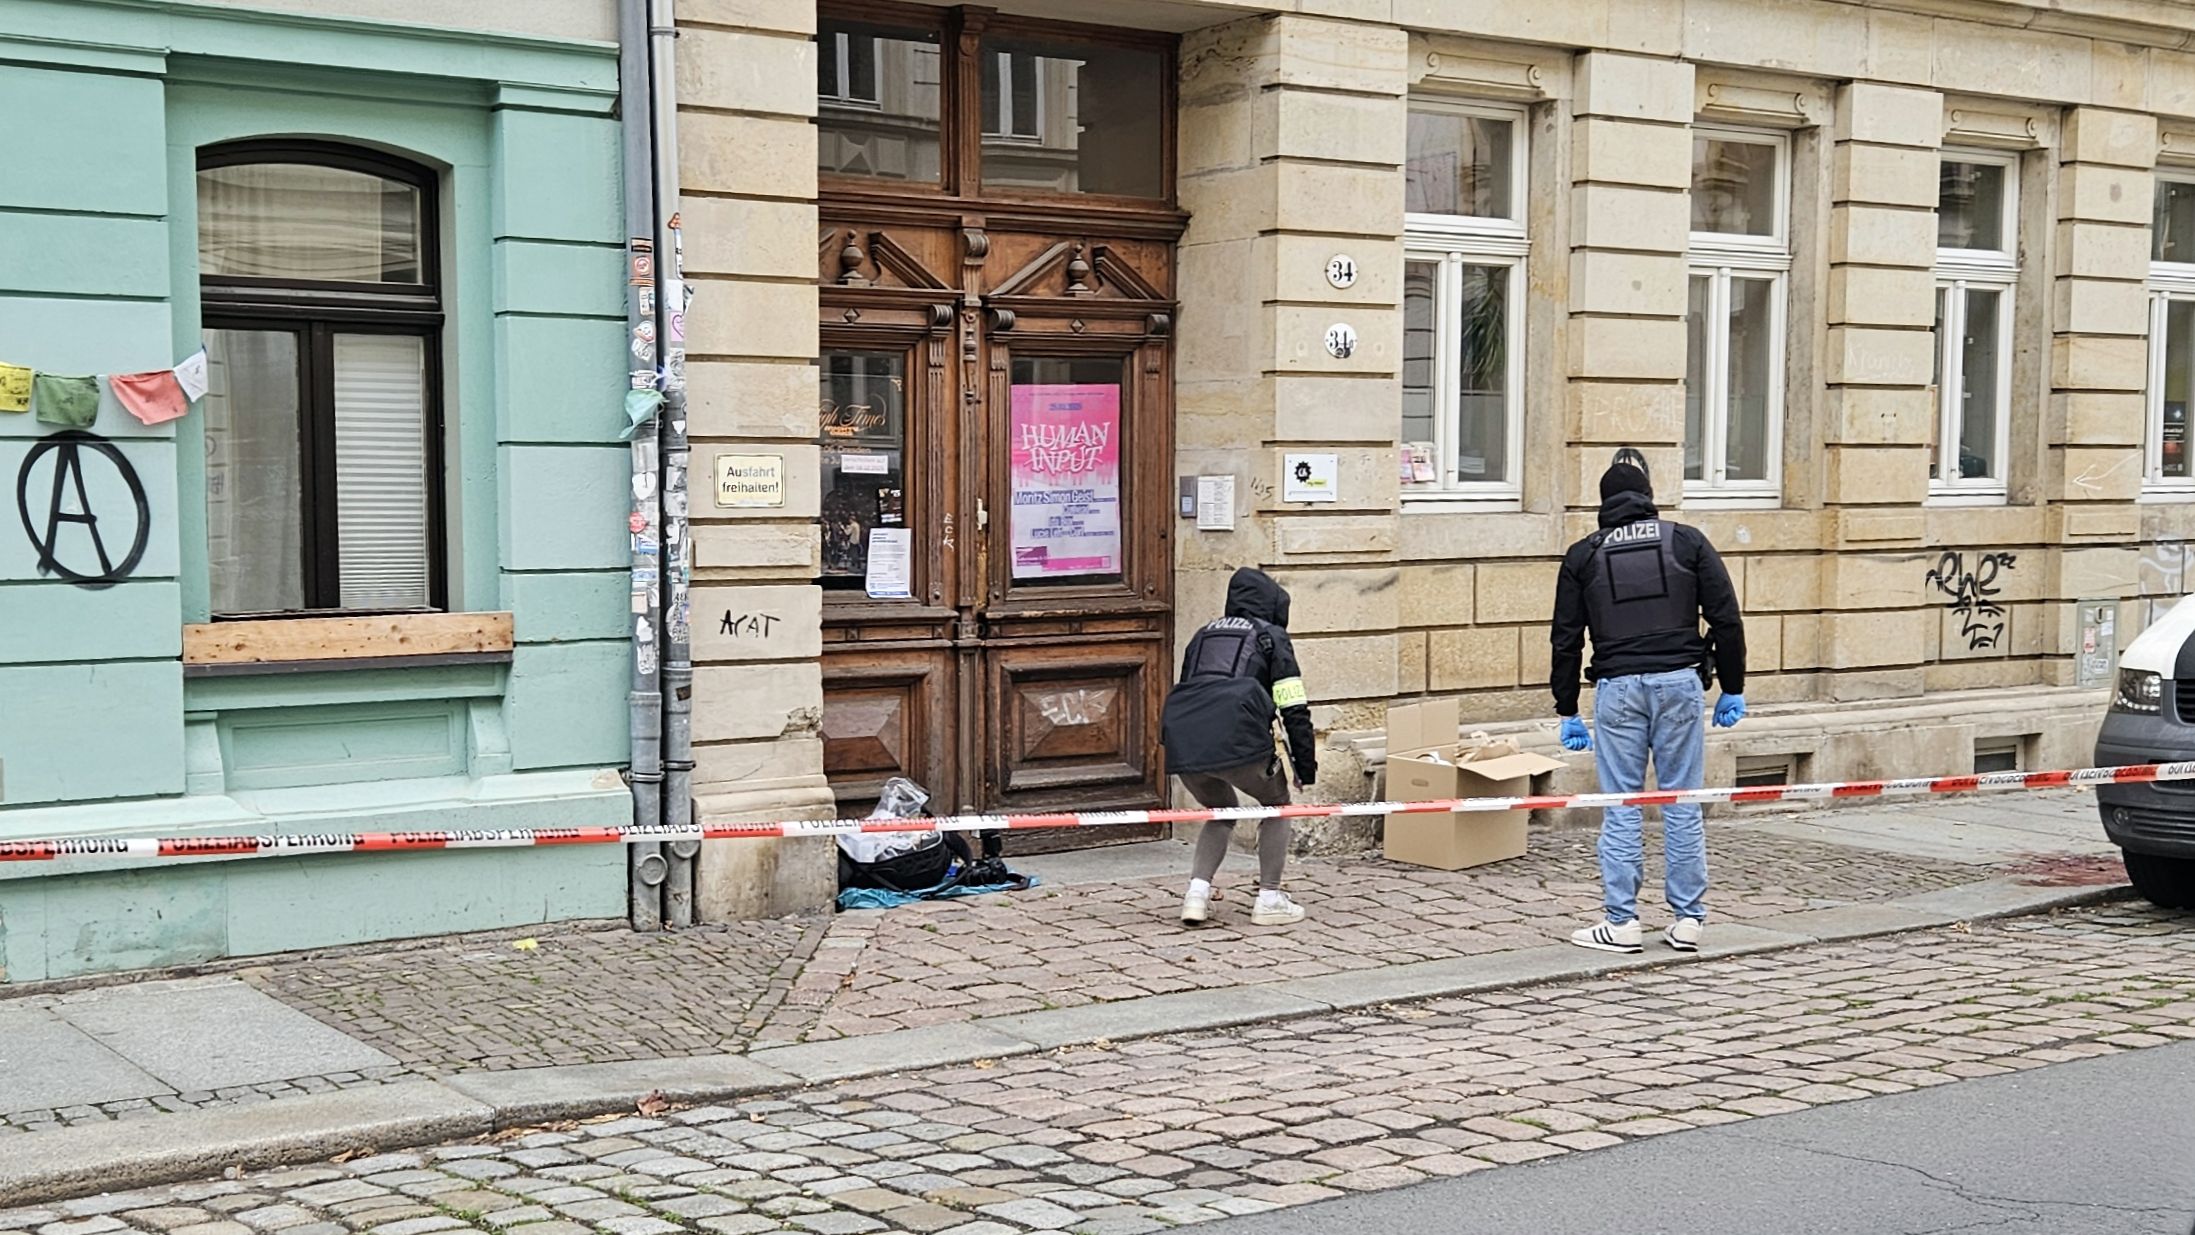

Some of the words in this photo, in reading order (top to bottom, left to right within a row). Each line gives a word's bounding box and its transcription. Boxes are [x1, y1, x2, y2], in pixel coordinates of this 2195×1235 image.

[1332, 260, 1353, 281] 34
[1020, 420, 1111, 450] HUMAN
[1028, 446, 1104, 475] INPUT
[726, 466, 776, 478] Ausfahrt
[722, 481, 779, 493] freihalten!
[1604, 522, 1661, 544] POLIZEI
